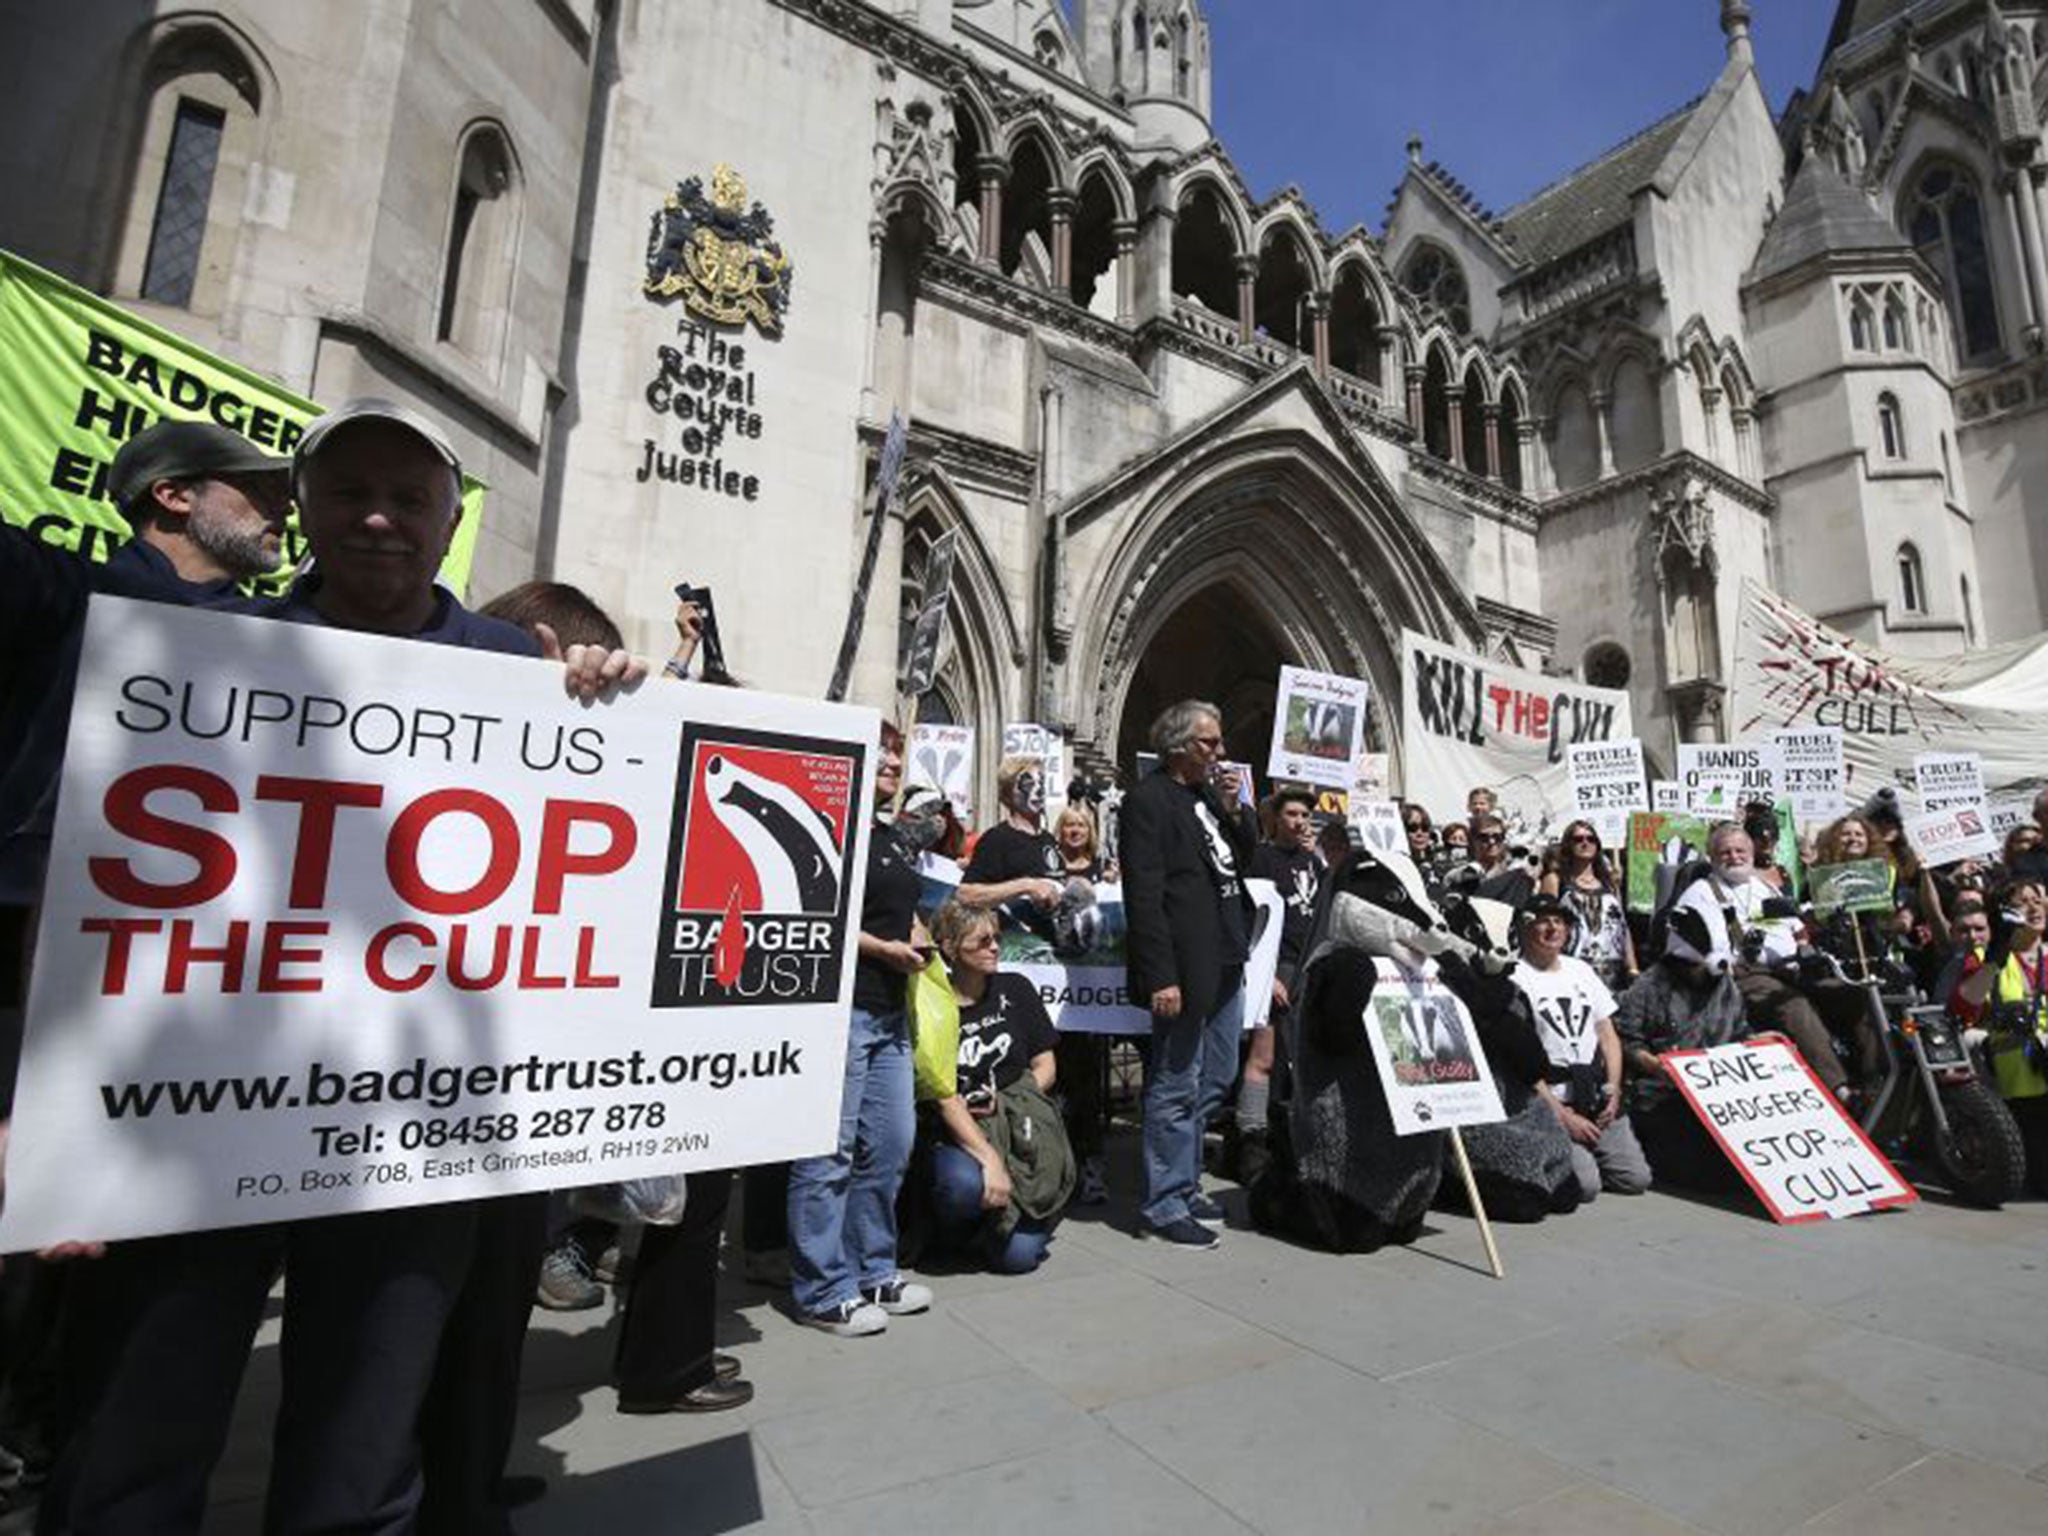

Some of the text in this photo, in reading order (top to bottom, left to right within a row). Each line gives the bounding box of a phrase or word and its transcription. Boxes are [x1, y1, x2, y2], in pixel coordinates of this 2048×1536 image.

[677, 318, 745, 371] The
[657, 344, 756, 407] Royal
[646, 378, 763, 440] Courts
[682, 420, 723, 459] of
[636, 438, 760, 502] Justice
[1413, 649, 1486, 746] KILL
[1815, 700, 1909, 735] CULL
[115, 675, 502, 764] SUPPORT
[520, 721, 605, 775] US
[1775, 734, 1839, 748] CRUEL
[1573, 747, 1638, 763] CRUEL
[1697, 750, 1760, 768] HANDS
[1919, 761, 1977, 775] CRUEL
[88, 763, 638, 915] STOP
[80, 918, 620, 995] THE CULL
[101, 1040, 803, 1119] www.badgertrust.org.uk
[1684, 1052, 1774, 1090] SAVE
[311, 1101, 666, 1157] Tel: 08458 287 878
[1708, 1088, 1825, 1127] BADGERS
[236, 1132, 710, 1198] P.O. Box 708, East Grinstead, RH19 2WN
[1744, 1129, 1826, 1166] STOP
[1785, 1162, 1883, 1204] CULL
